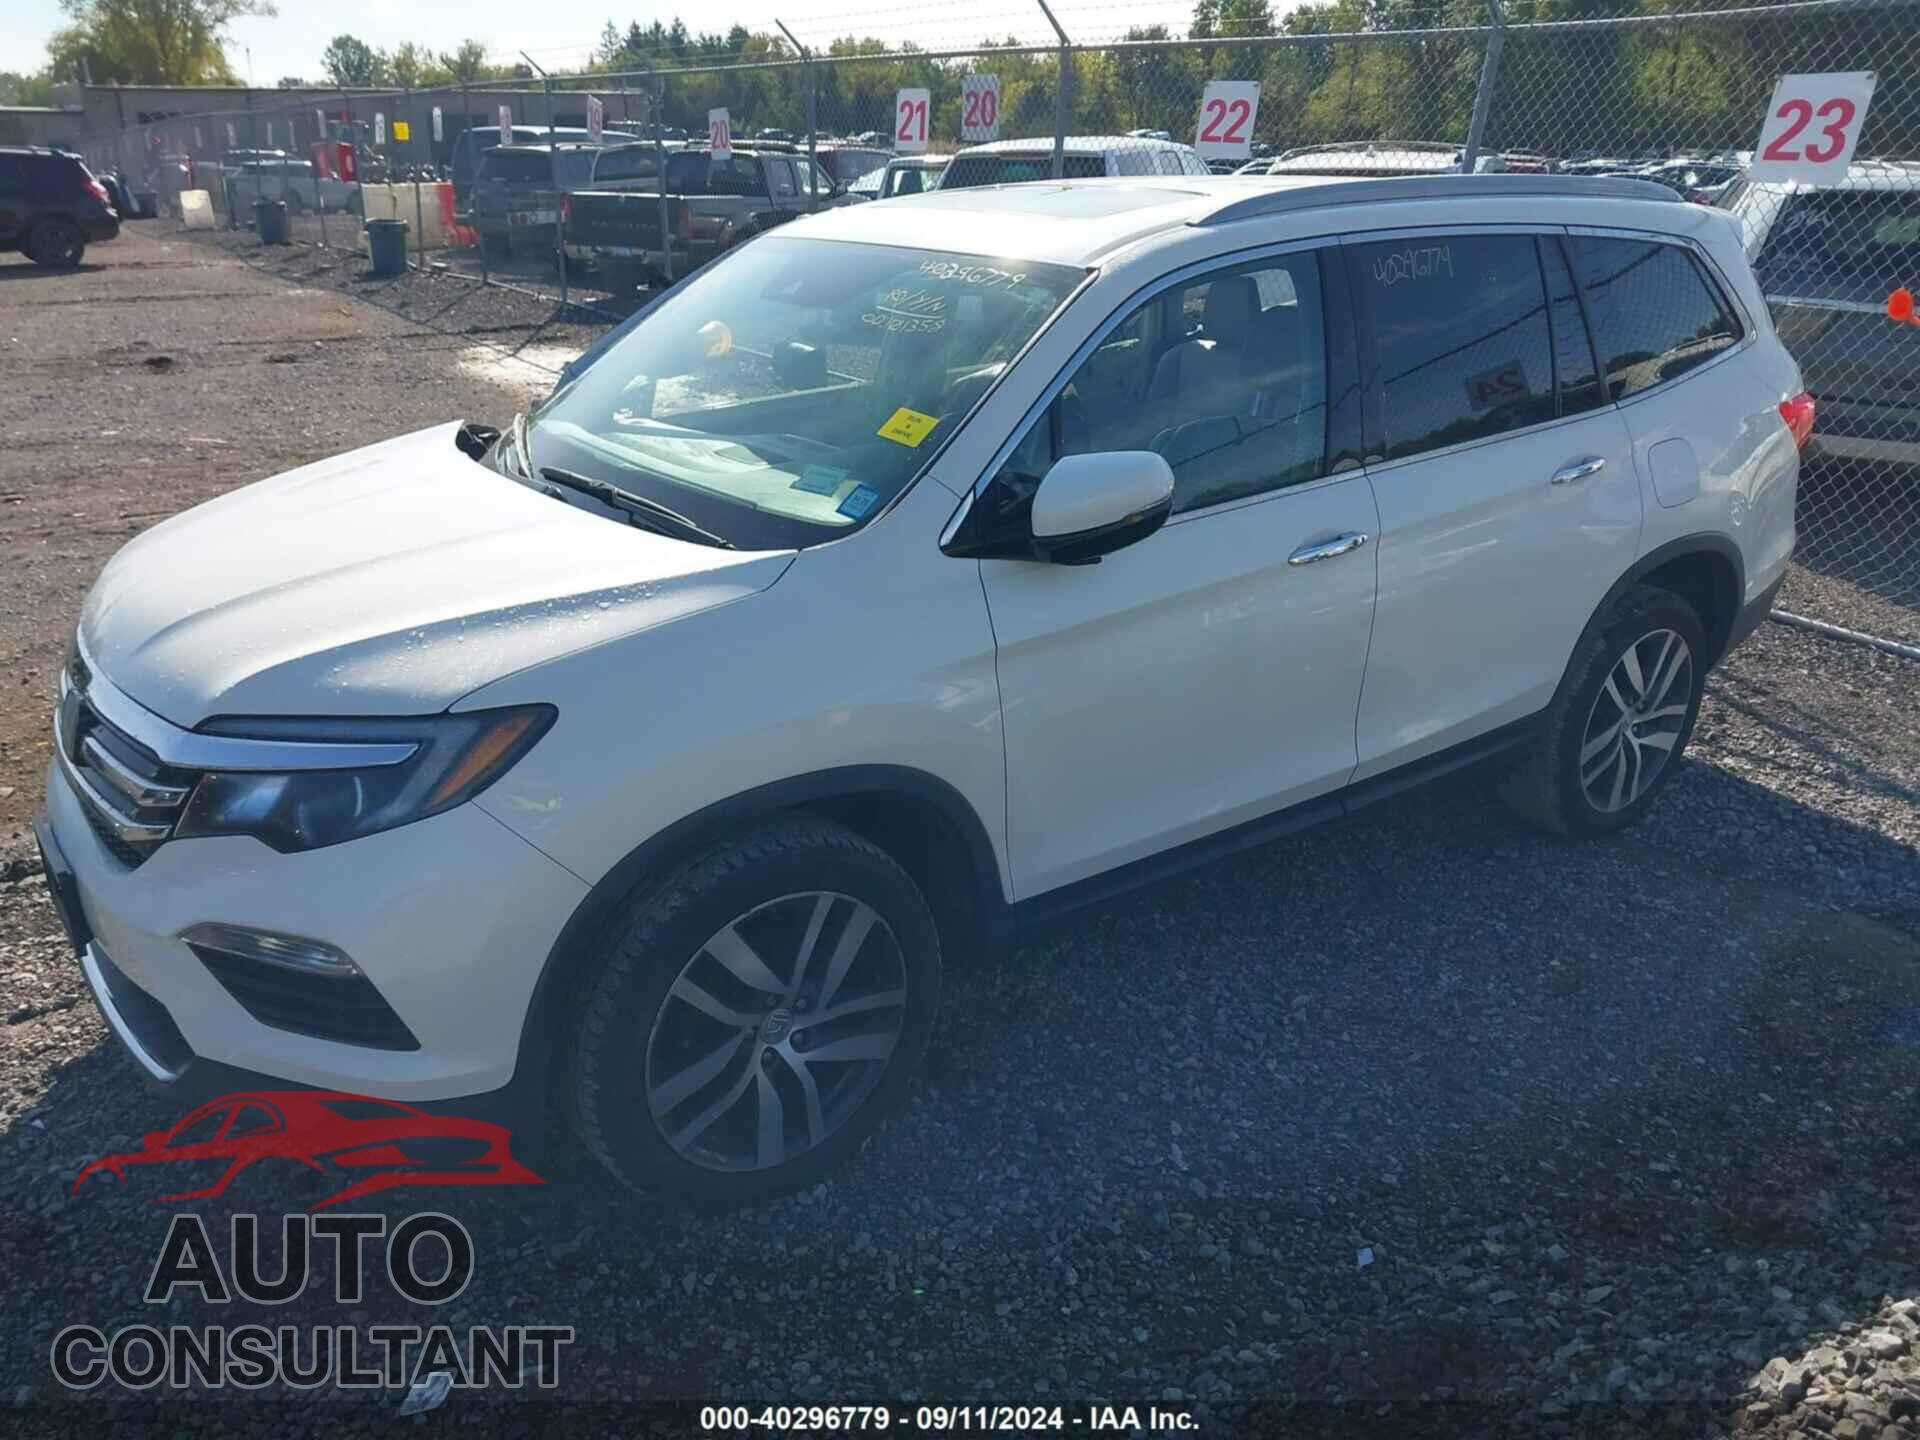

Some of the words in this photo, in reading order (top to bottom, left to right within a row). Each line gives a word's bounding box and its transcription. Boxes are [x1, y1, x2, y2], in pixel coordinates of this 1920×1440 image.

[898, 100, 927, 141] 21
[965, 90, 996, 128] 20
[1200, 98, 1250, 144] 22
[711, 120, 728, 149] 20
[1762, 98, 1855, 163] 23
